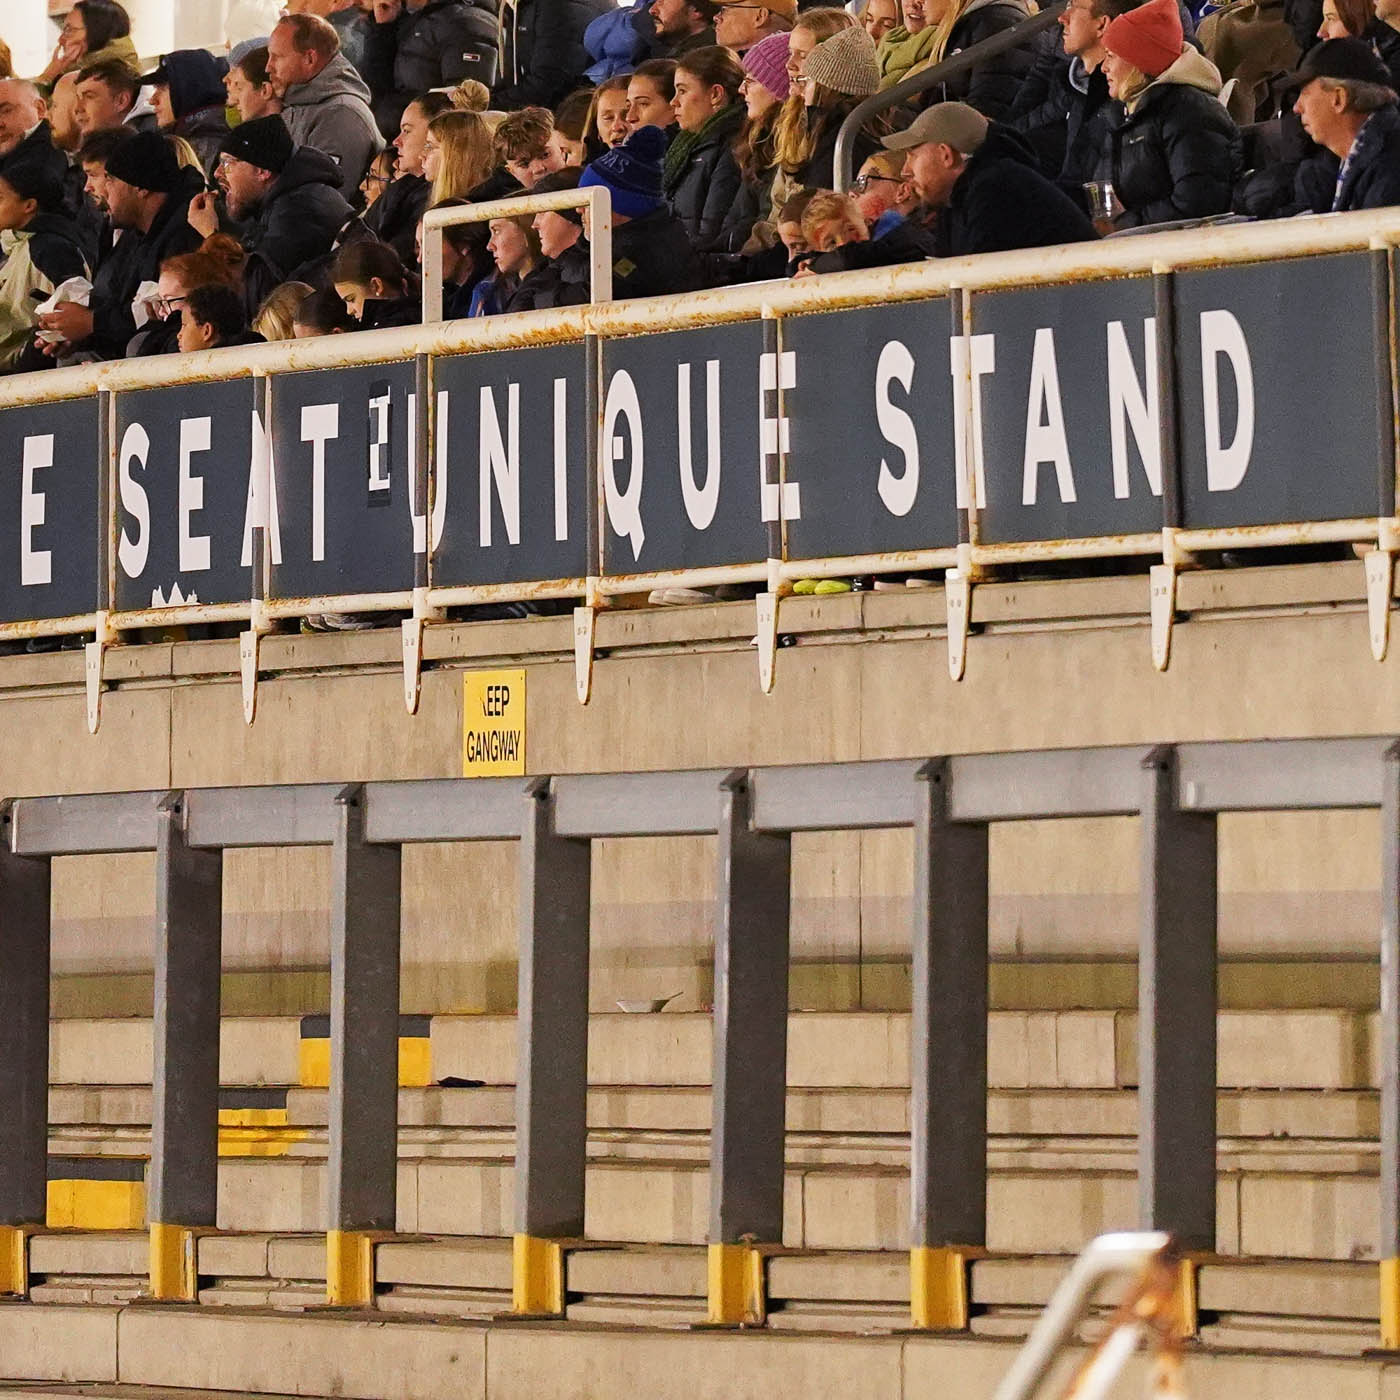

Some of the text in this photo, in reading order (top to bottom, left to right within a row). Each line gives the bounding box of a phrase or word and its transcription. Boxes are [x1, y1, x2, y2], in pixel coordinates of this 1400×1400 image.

[118, 403, 339, 579] SEAT
[407, 351, 801, 562] UNIQUE
[875, 308, 1255, 517] STAND
[479, 685, 511, 717] EEP
[466, 729, 521, 763] GANGWAY
